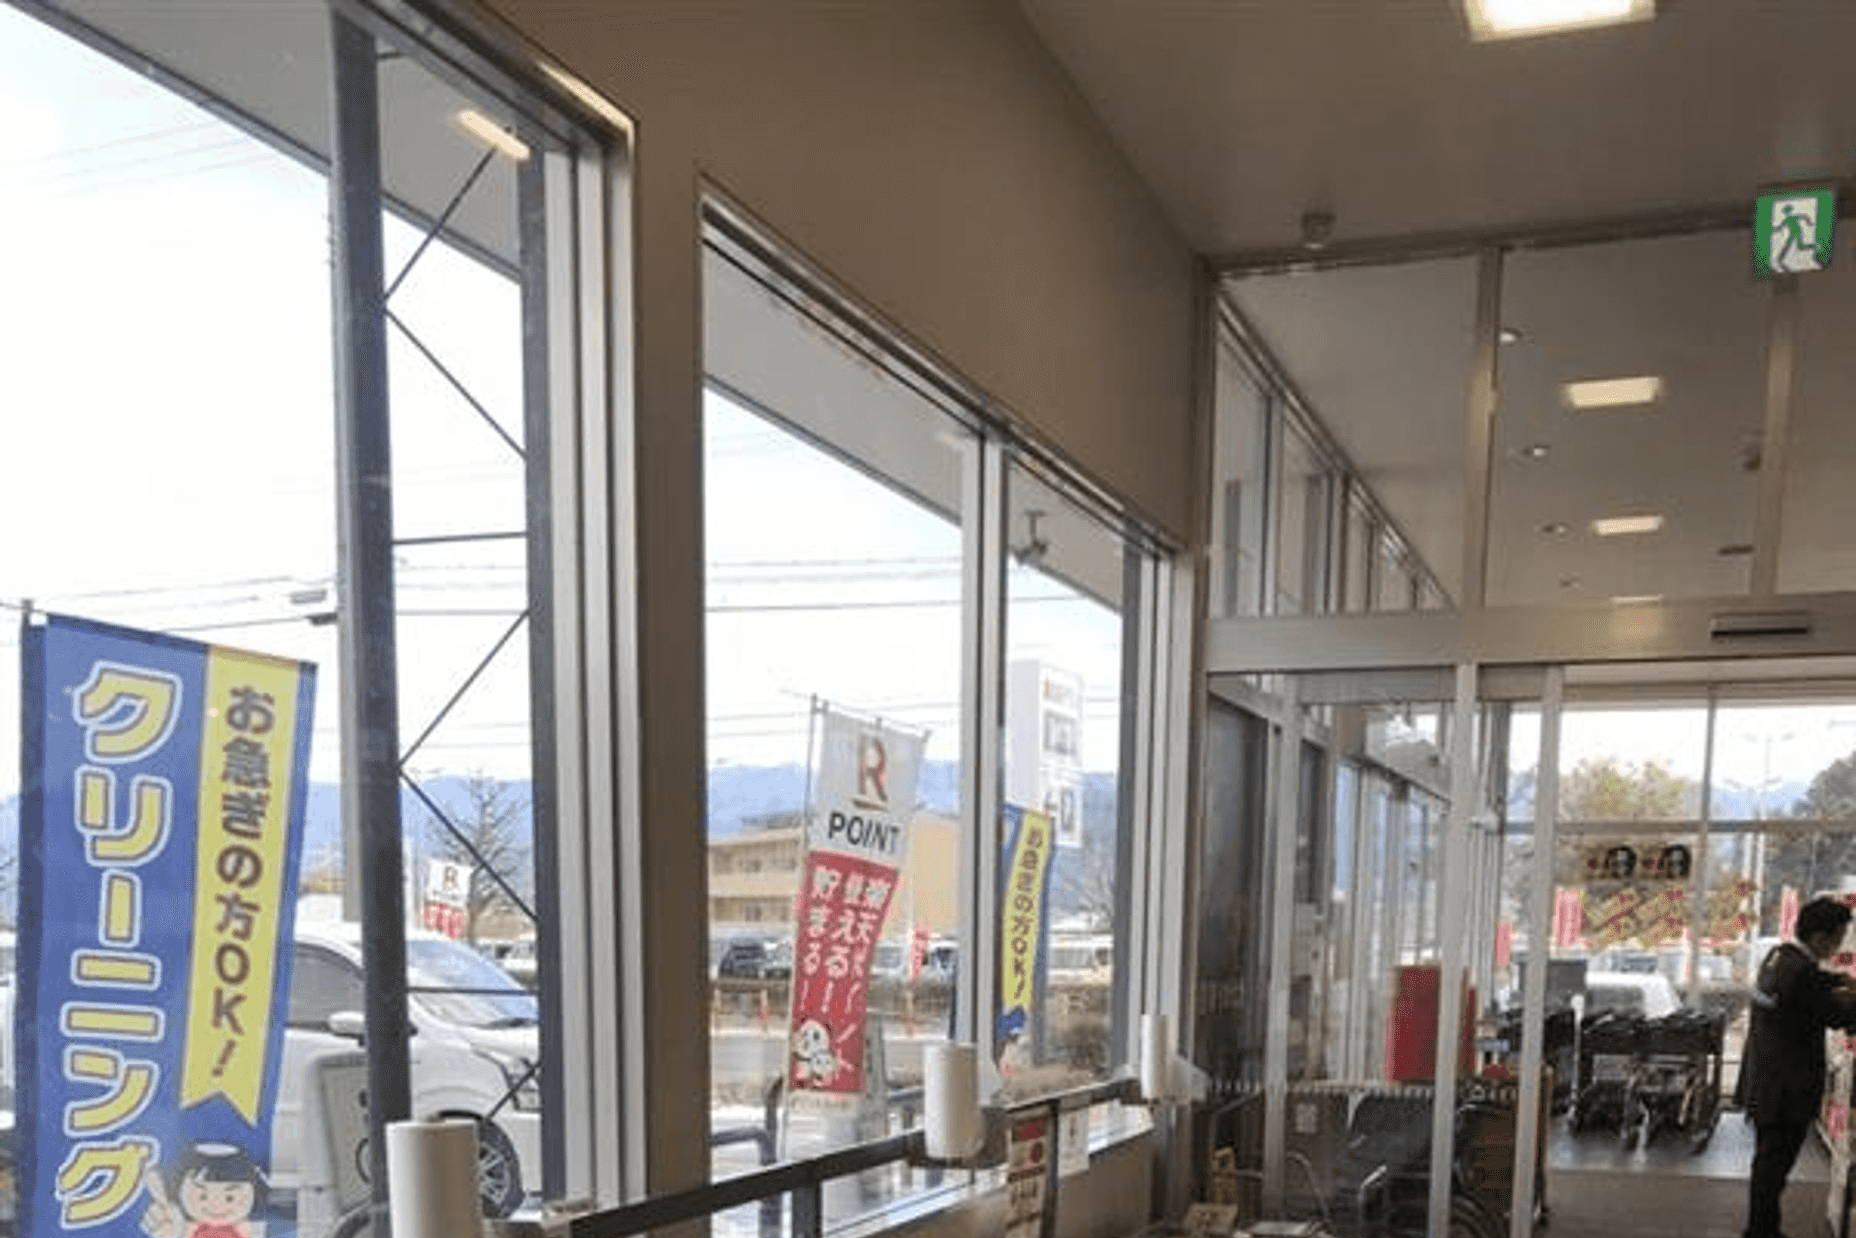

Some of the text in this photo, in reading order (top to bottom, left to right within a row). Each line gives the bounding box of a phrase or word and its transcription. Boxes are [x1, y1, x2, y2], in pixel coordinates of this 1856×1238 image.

[58, 661, 182, 1230] クリーニング
[211, 685, 276, 1078] お急ぎの方OK!
[828, 812, 900, 853] POINT
